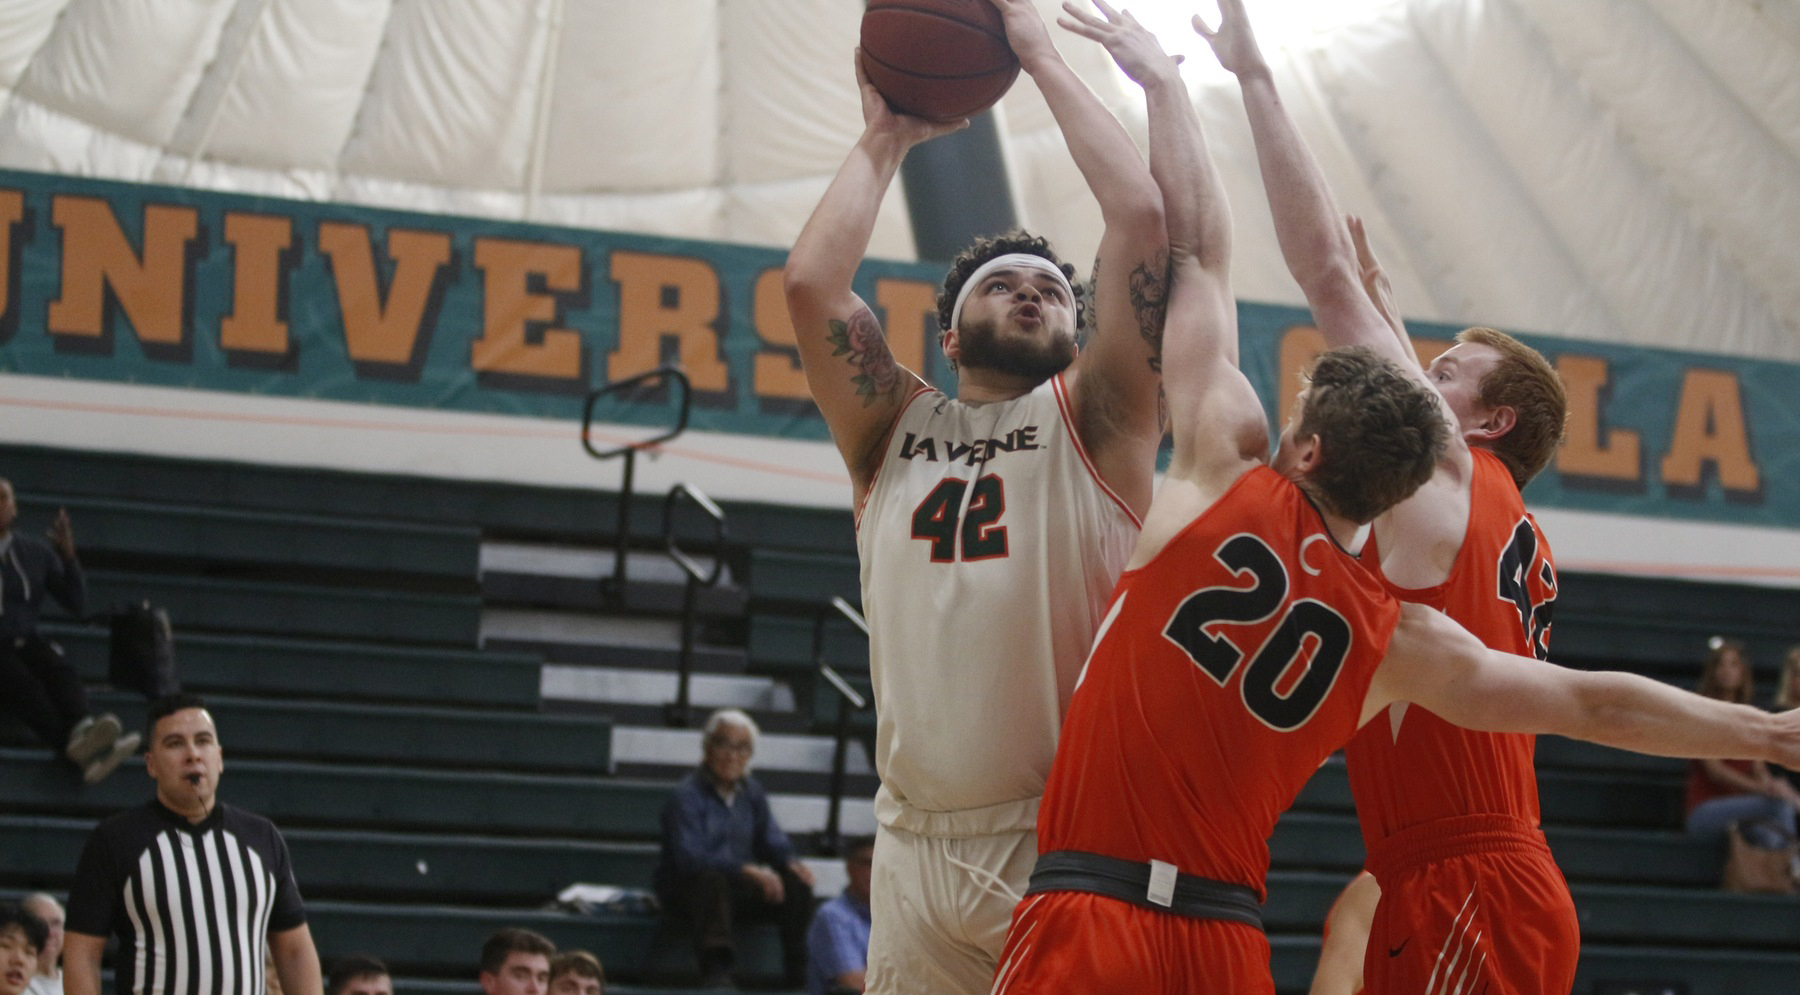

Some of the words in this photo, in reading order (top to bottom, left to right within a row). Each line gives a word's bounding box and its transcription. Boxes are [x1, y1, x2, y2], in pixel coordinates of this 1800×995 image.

[899, 432, 938, 461] LA
[943, 426, 1039, 467] VENE
[1556, 356, 1759, 492] LA
[911, 473, 1009, 563] 42
[1161, 532, 1352, 733] 20
